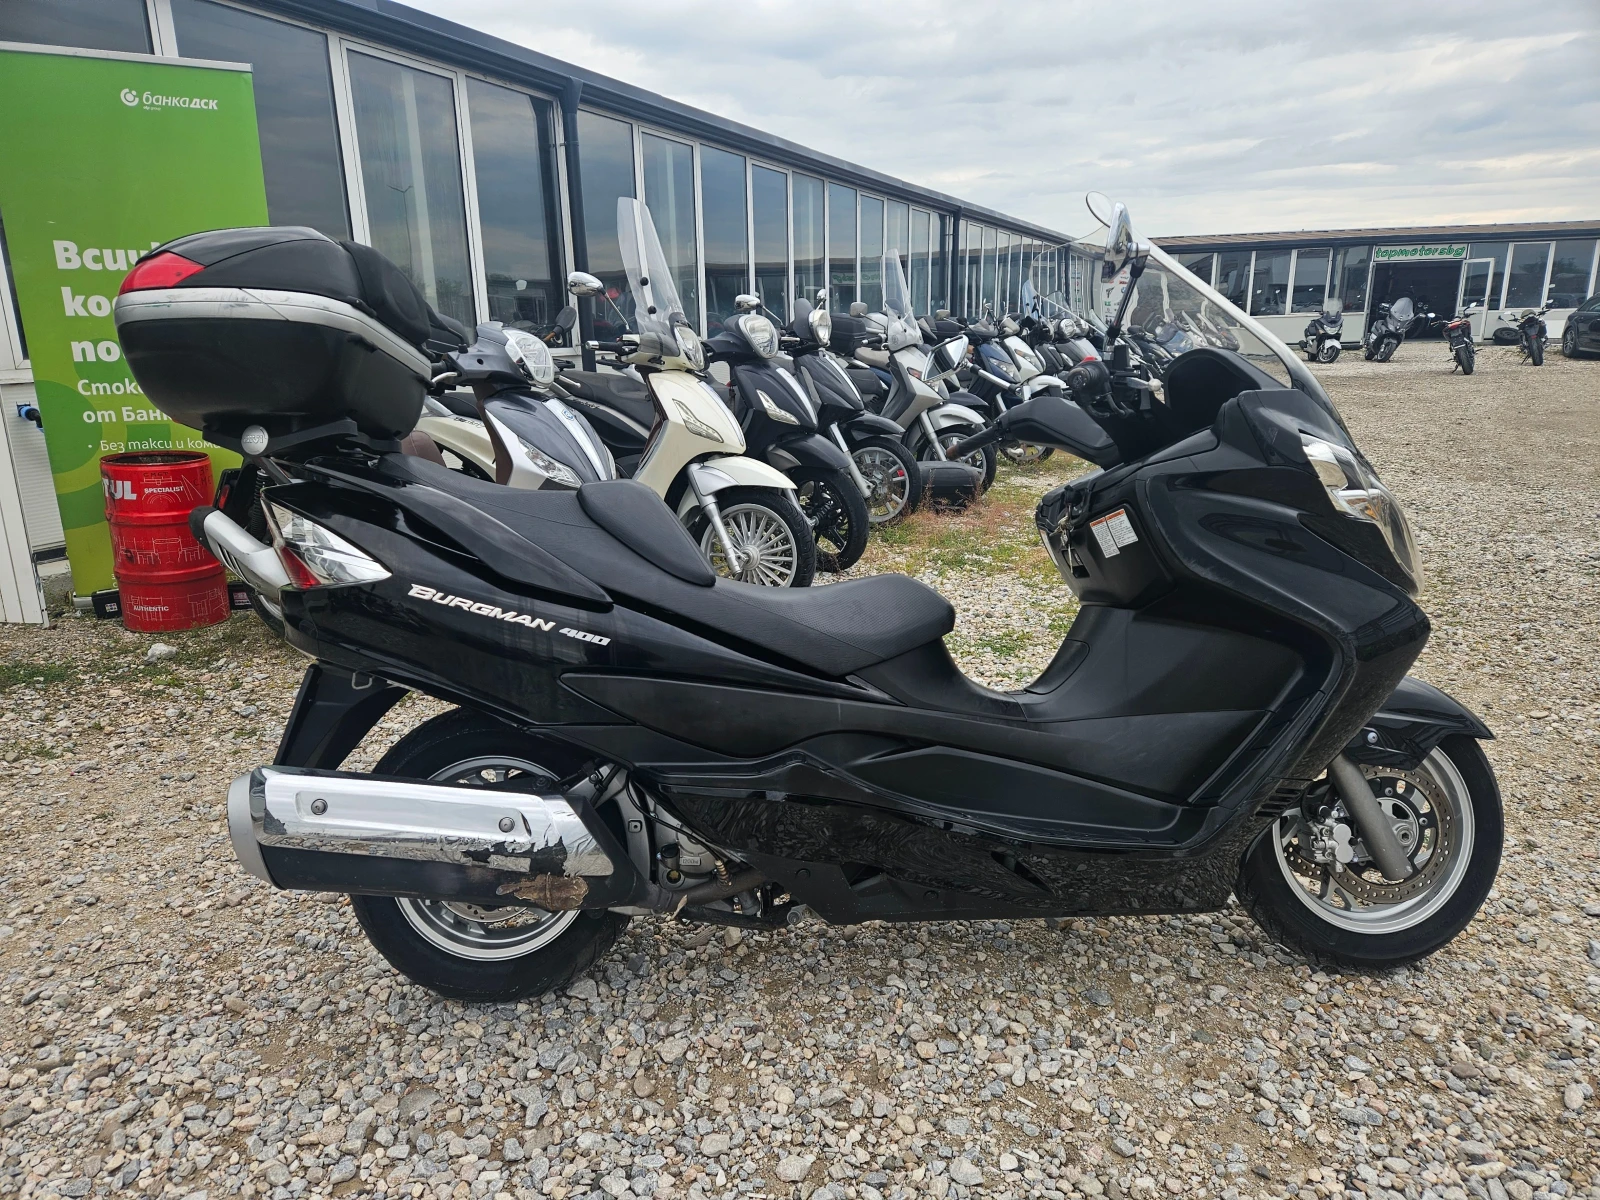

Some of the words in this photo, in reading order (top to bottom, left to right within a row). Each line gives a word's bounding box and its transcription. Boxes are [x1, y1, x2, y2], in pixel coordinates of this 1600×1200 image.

[53, 240, 160, 271] Вси
[61, 287, 118, 317] ко
[83, 410, 117, 423] от
[101, 440, 125, 453] Без
[128, 438, 173, 450] такси
[176, 441, 184, 449] и
[144, 485, 184, 494] SPECIALIST
[408, 583, 556, 632] BURGMAN
[559, 627, 612, 646] 400
